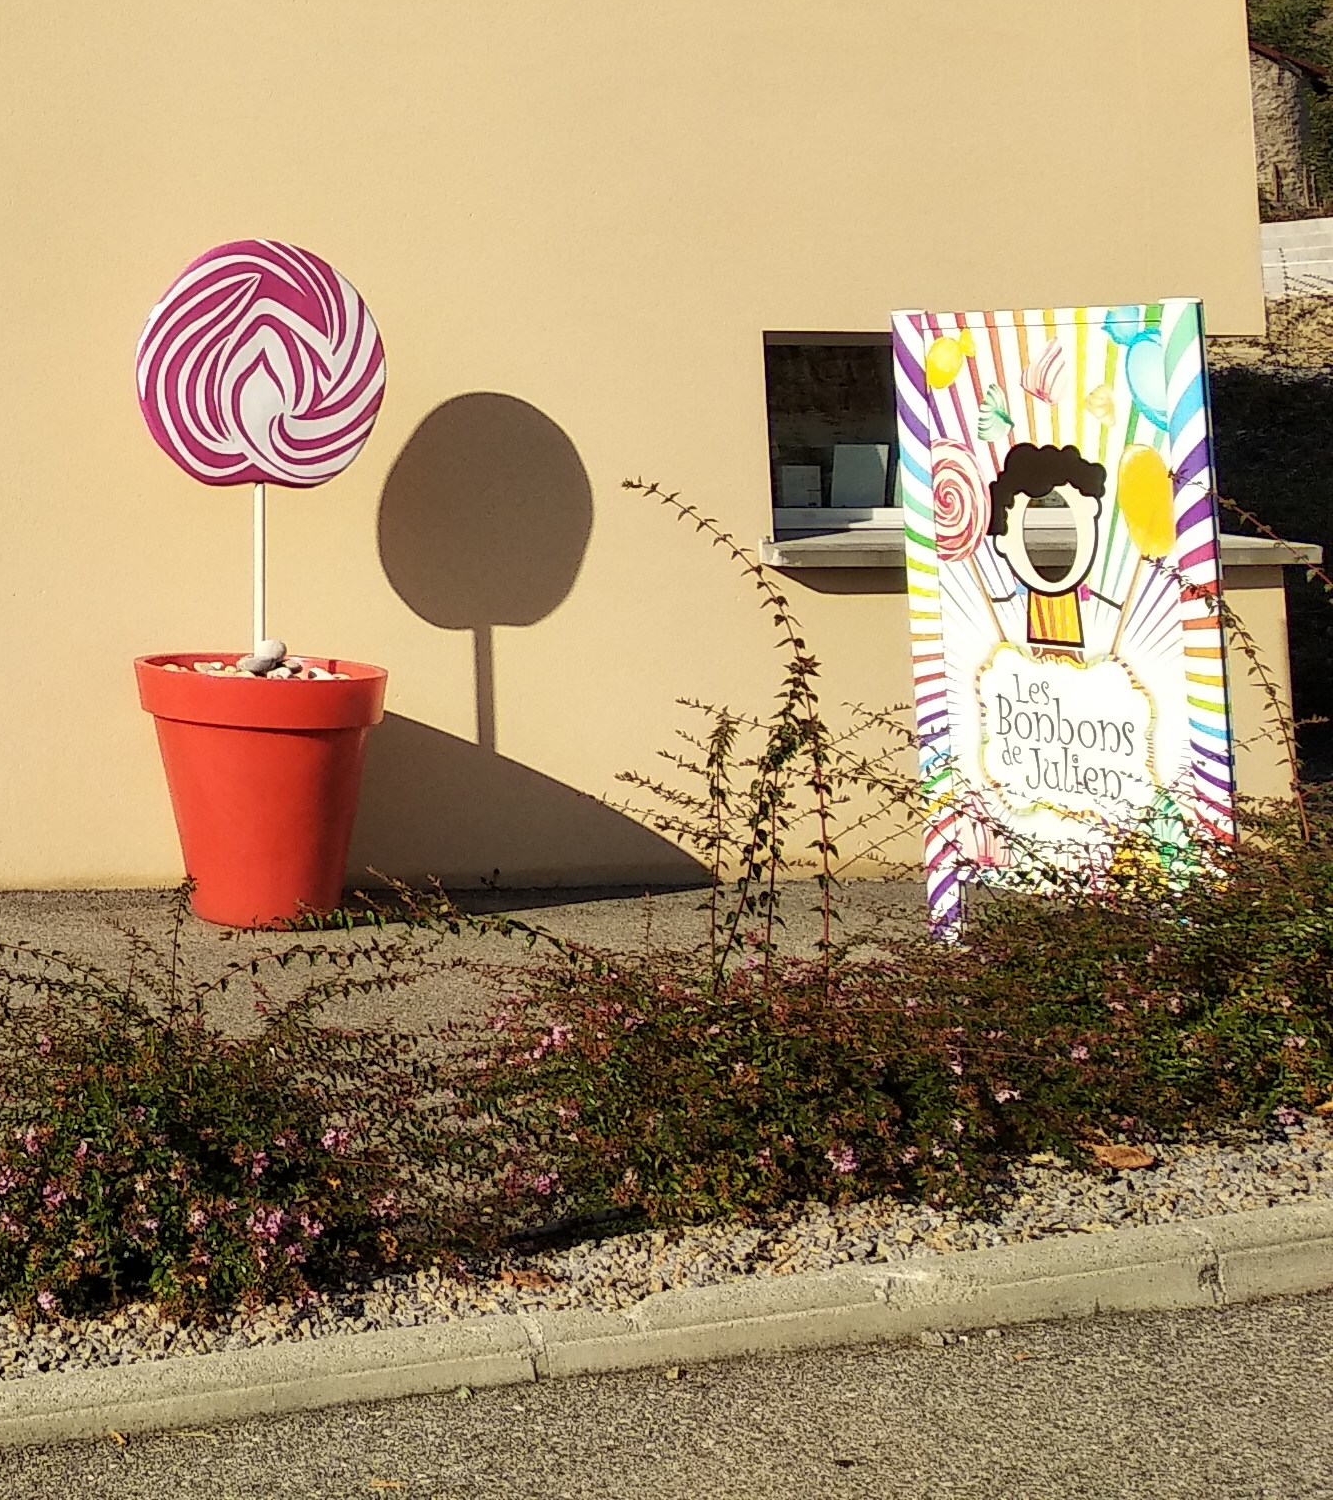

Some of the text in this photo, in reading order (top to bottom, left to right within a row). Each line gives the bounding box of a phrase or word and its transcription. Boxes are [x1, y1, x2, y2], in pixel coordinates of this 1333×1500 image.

[1012, 673, 1050, 705] Les
[995, 693, 1135, 756] Bonbons
[1001, 737, 1023, 766] de
[1025, 746, 1122, 800] Julien
